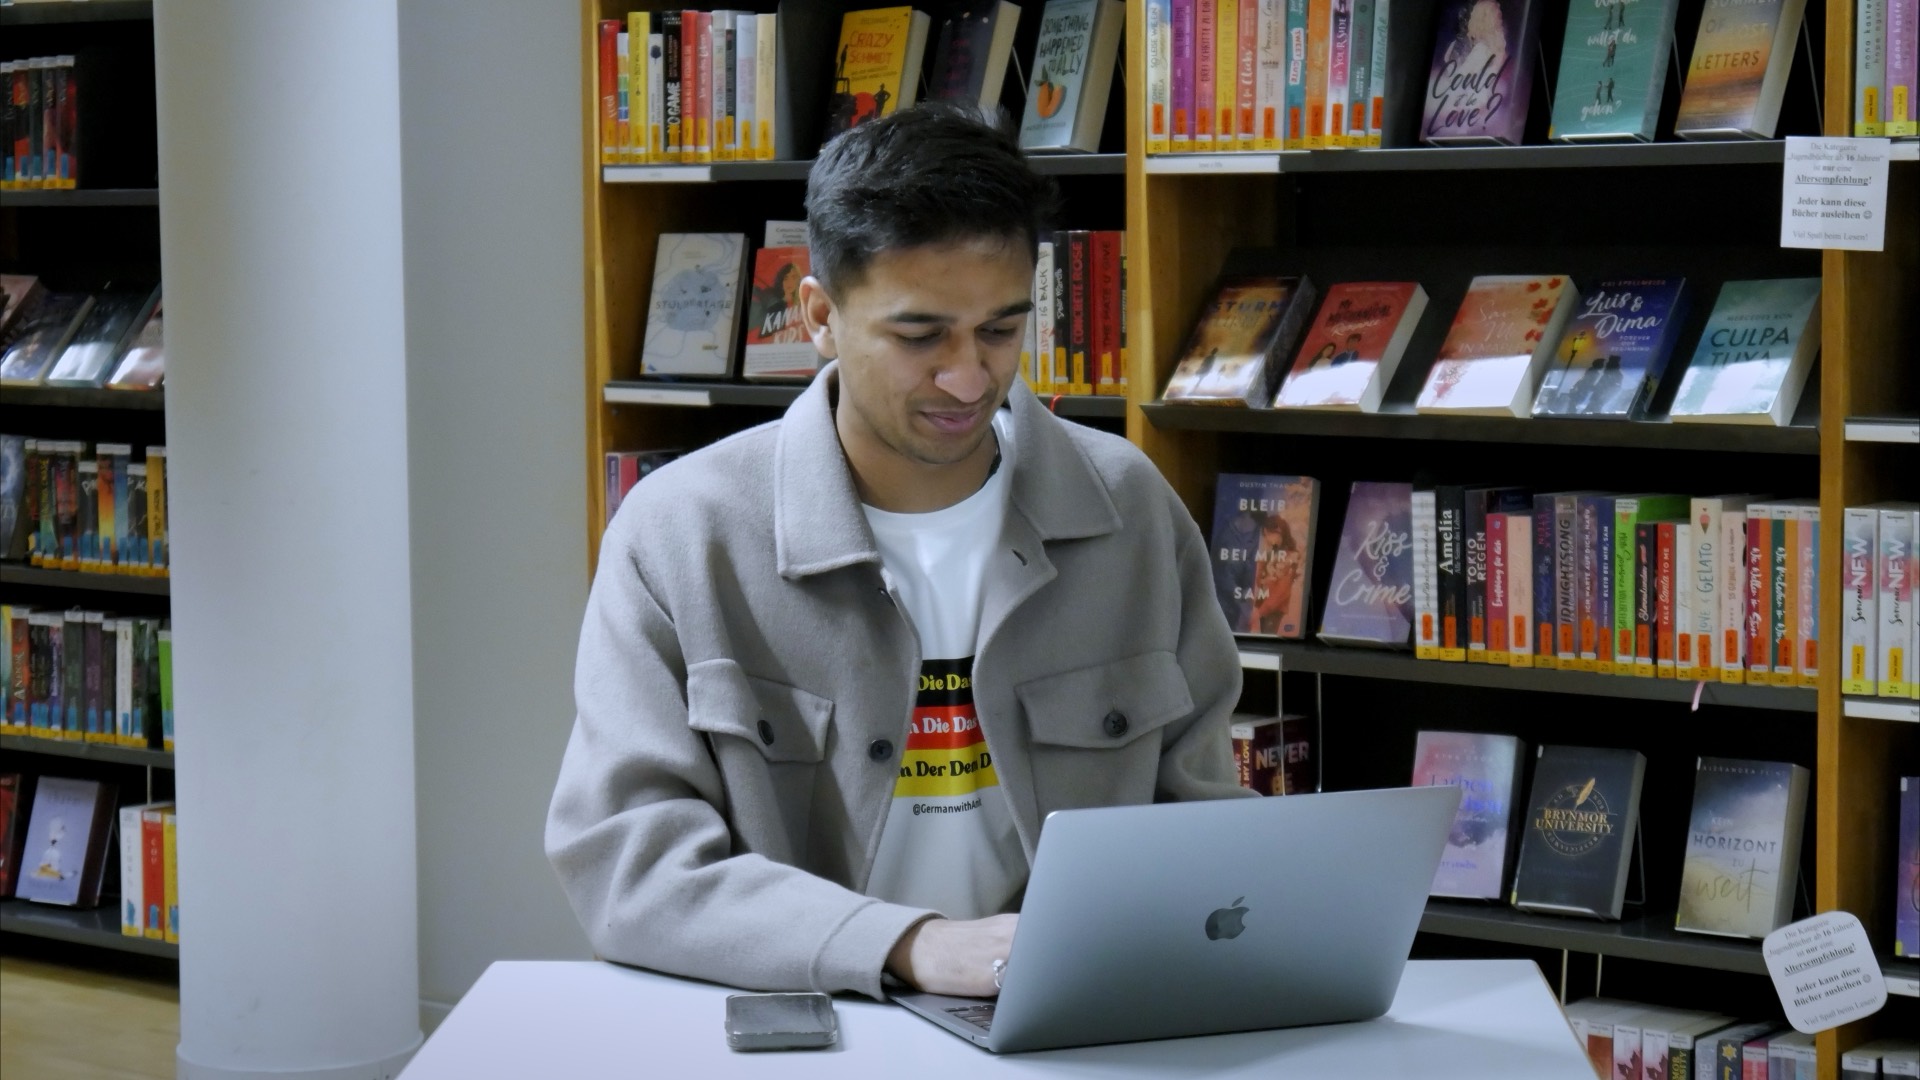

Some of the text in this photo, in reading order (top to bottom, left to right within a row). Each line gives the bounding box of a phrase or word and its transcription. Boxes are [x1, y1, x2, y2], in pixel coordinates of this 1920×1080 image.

[1042, 14, 1089, 36] SOMETHING
[849, 30, 895, 49] CRAZY
[1039, 34, 1083, 58] HAPPENED
[1622, 29, 1637, 44] du
[848, 51, 893, 65] SCHMIDT
[1056, 52, 1082, 75] ALLY
[1291, 30, 1302, 83] TWEET CUTE
[1696, 51, 1760, 70] LETTERS
[1894, 40, 1902, 69] mona
[1432, 54, 1510, 99] Could
[667, 82, 681, 115] GAME
[1427, 93, 1504, 135] Love?
[1581, 100, 1622, 121] gehen?
[1795, 174, 1872, 187] Altersempfehlung!
[1797, 197, 1867, 207] Jeder kann diese
[1792, 208, 1861, 220] Bücher ausleihen
[1793, 230, 1806, 238] Viel
[1824, 232, 1841, 240] beim
[1038, 268, 1049, 302] BACK
[1072, 241, 1084, 345] CONCRETE ROSE
[1577, 290, 1633, 320] Luis
[761, 304, 803, 335] KANA
[1595, 314, 1663, 340] Dima
[1710, 326, 1790, 348] CULPA
[1239, 481, 1268, 489] DUSTIN
[1239, 498, 1287, 512] BLEIB
[1354, 520, 1412, 561] Kiss
[1438, 509, 1453, 575] Amelia
[1220, 547, 1247, 561] BEI
[1467, 538, 1477, 585] TOKIO
[1477, 532, 1487, 581] REGEN
[1663, 547, 1670, 560] ME
[1373, 555, 1390, 581] &
[1559, 519, 1571, 624] IDNIGHTSONG
[1663, 561, 1670, 574] TO
[1696, 542, 1714, 593] GELATO
[1335, 568, 1411, 607] Crime
[1659, 575, 1670, 604] Santa
[1852, 536, 1867, 622] Someone NEW
[1888, 541, 1904, 625] Someone NEW
[1234, 586, 1270, 600] SAM
[918, 674, 972, 691] Die Das
[922, 716, 977, 734] Die Das
[915, 760, 947, 777] Der
[1535, 818, 1614, 834] UNIVERSITY
[1543, 807, 1608, 824] BRYNMOR
[1693, 834, 1777, 854] HORIZONT
[1696, 858, 1769, 914] weit
[1785, 930, 1798, 940] Die
[1823, 928, 1832, 937] 16
[1784, 942, 1856, 977] Altersempfehlung!
[1806, 946, 1818, 955] nur
[1795, 966, 1861, 995] Jeder kann diese
[1793, 979, 1862, 1008] Bücher ausleihen
[1804, 1015, 1819, 1027] Viel
[1837, 1005, 1854, 1017] beim
